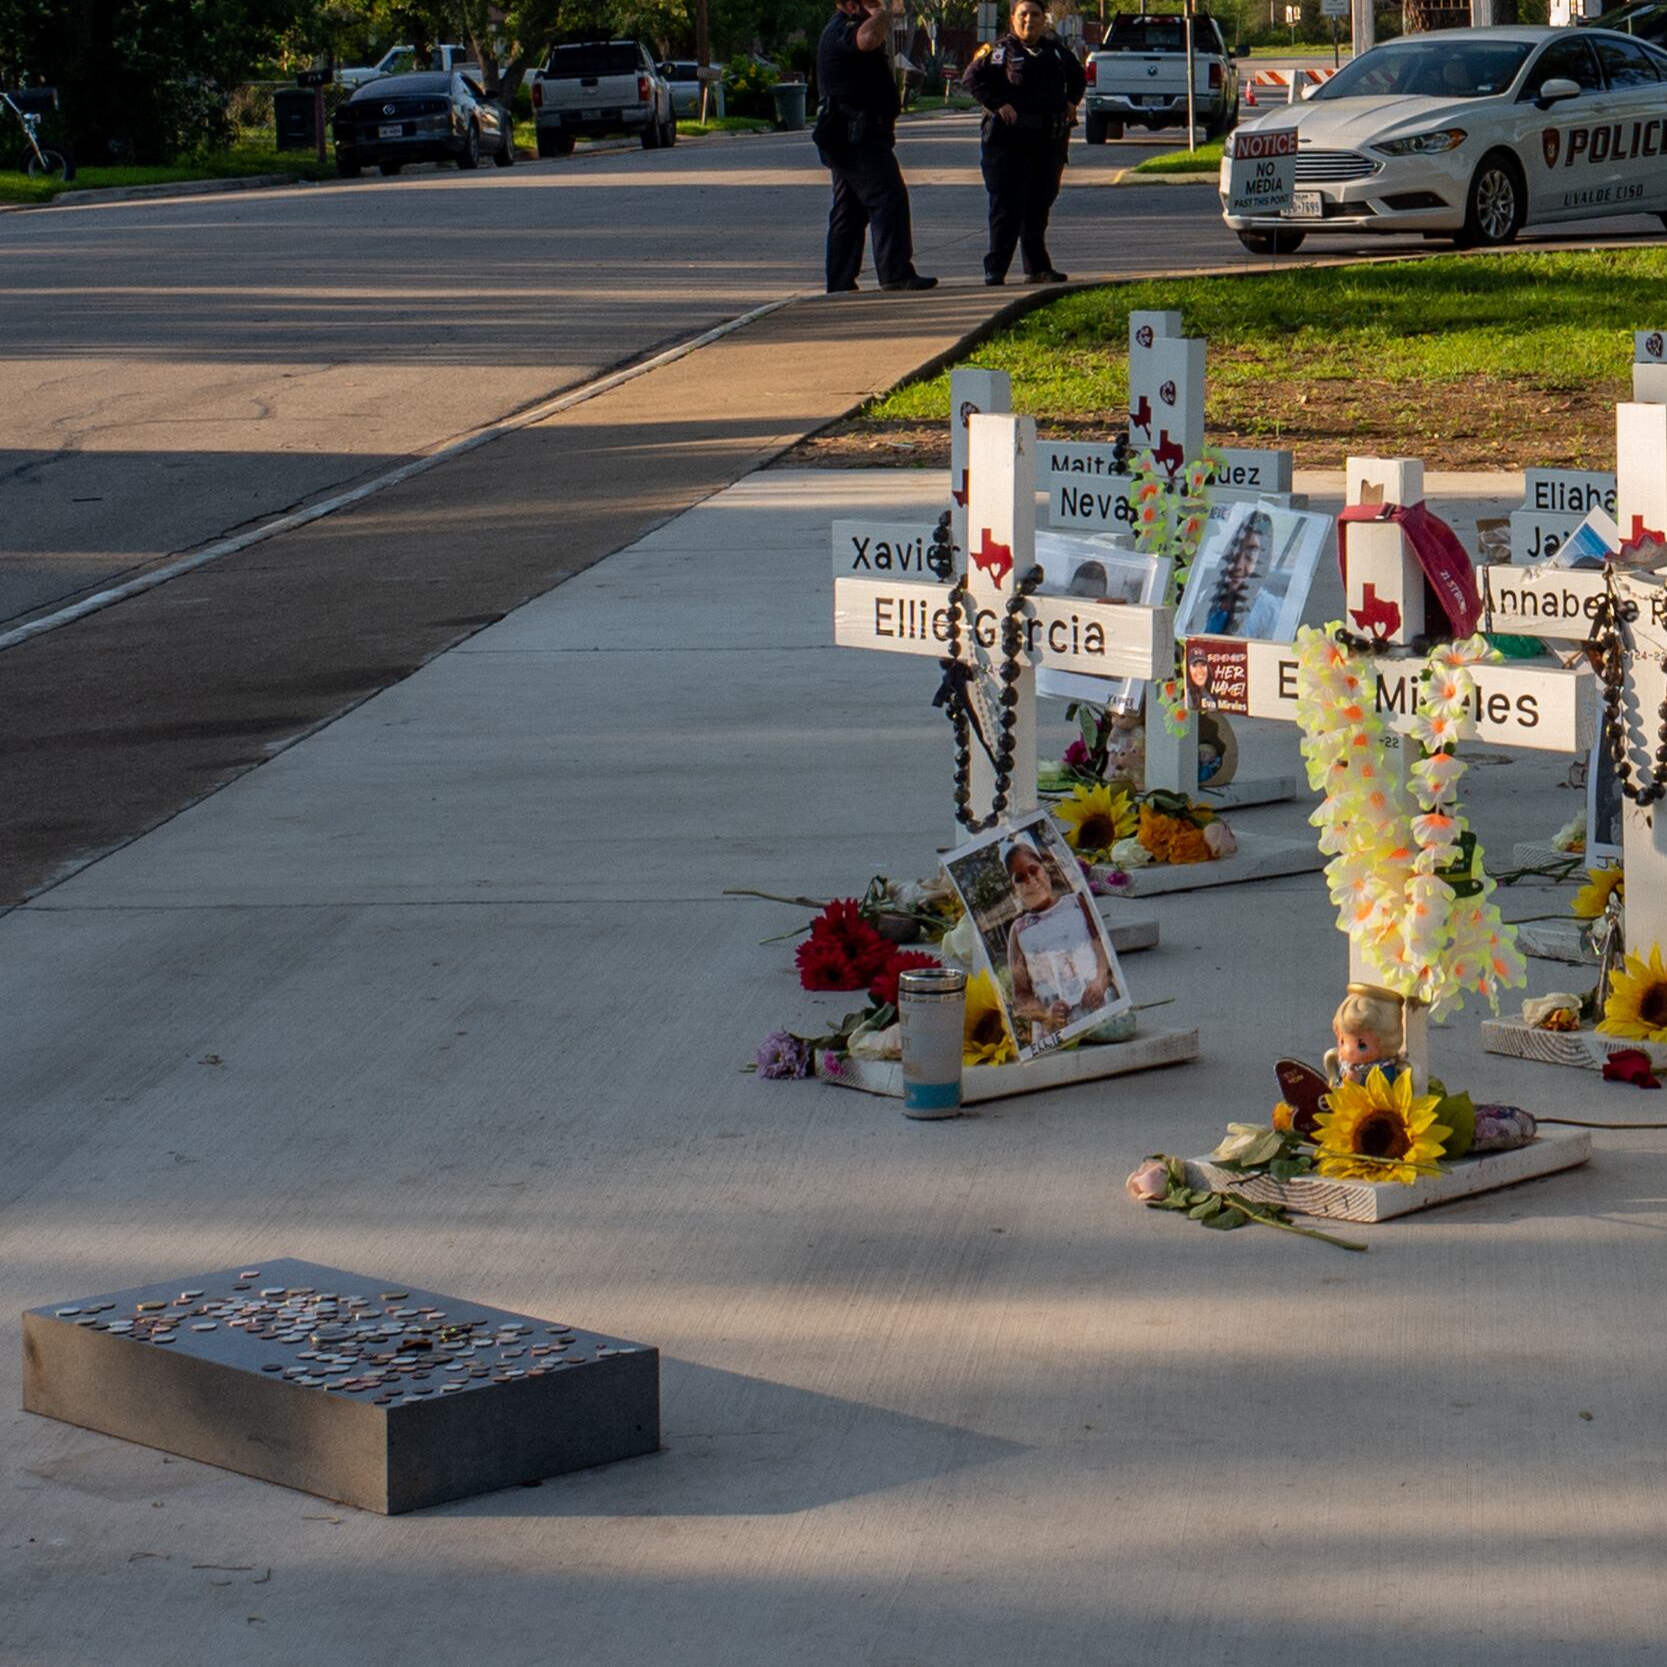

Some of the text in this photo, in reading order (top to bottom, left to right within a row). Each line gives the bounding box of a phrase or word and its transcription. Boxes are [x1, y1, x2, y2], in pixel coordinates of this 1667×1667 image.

[1237, 132, 1296, 158] NOTICE
[1256, 161, 1275, 177] NO
[1245, 178, 1283, 195] MEDIA
[1564, 184, 1643, 206] UVALDE CISD
[1234, 197, 1252, 208] PAST
[1253, 196, 1269, 207] THIS
[1270, 194, 1290, 206] POINT
[1061, 487, 1131, 520] Neva
[874, 597, 1106, 656] Ellie Grcia
[1215, 665, 1246, 680] HER
[1375, 673, 1540, 728] Miles
